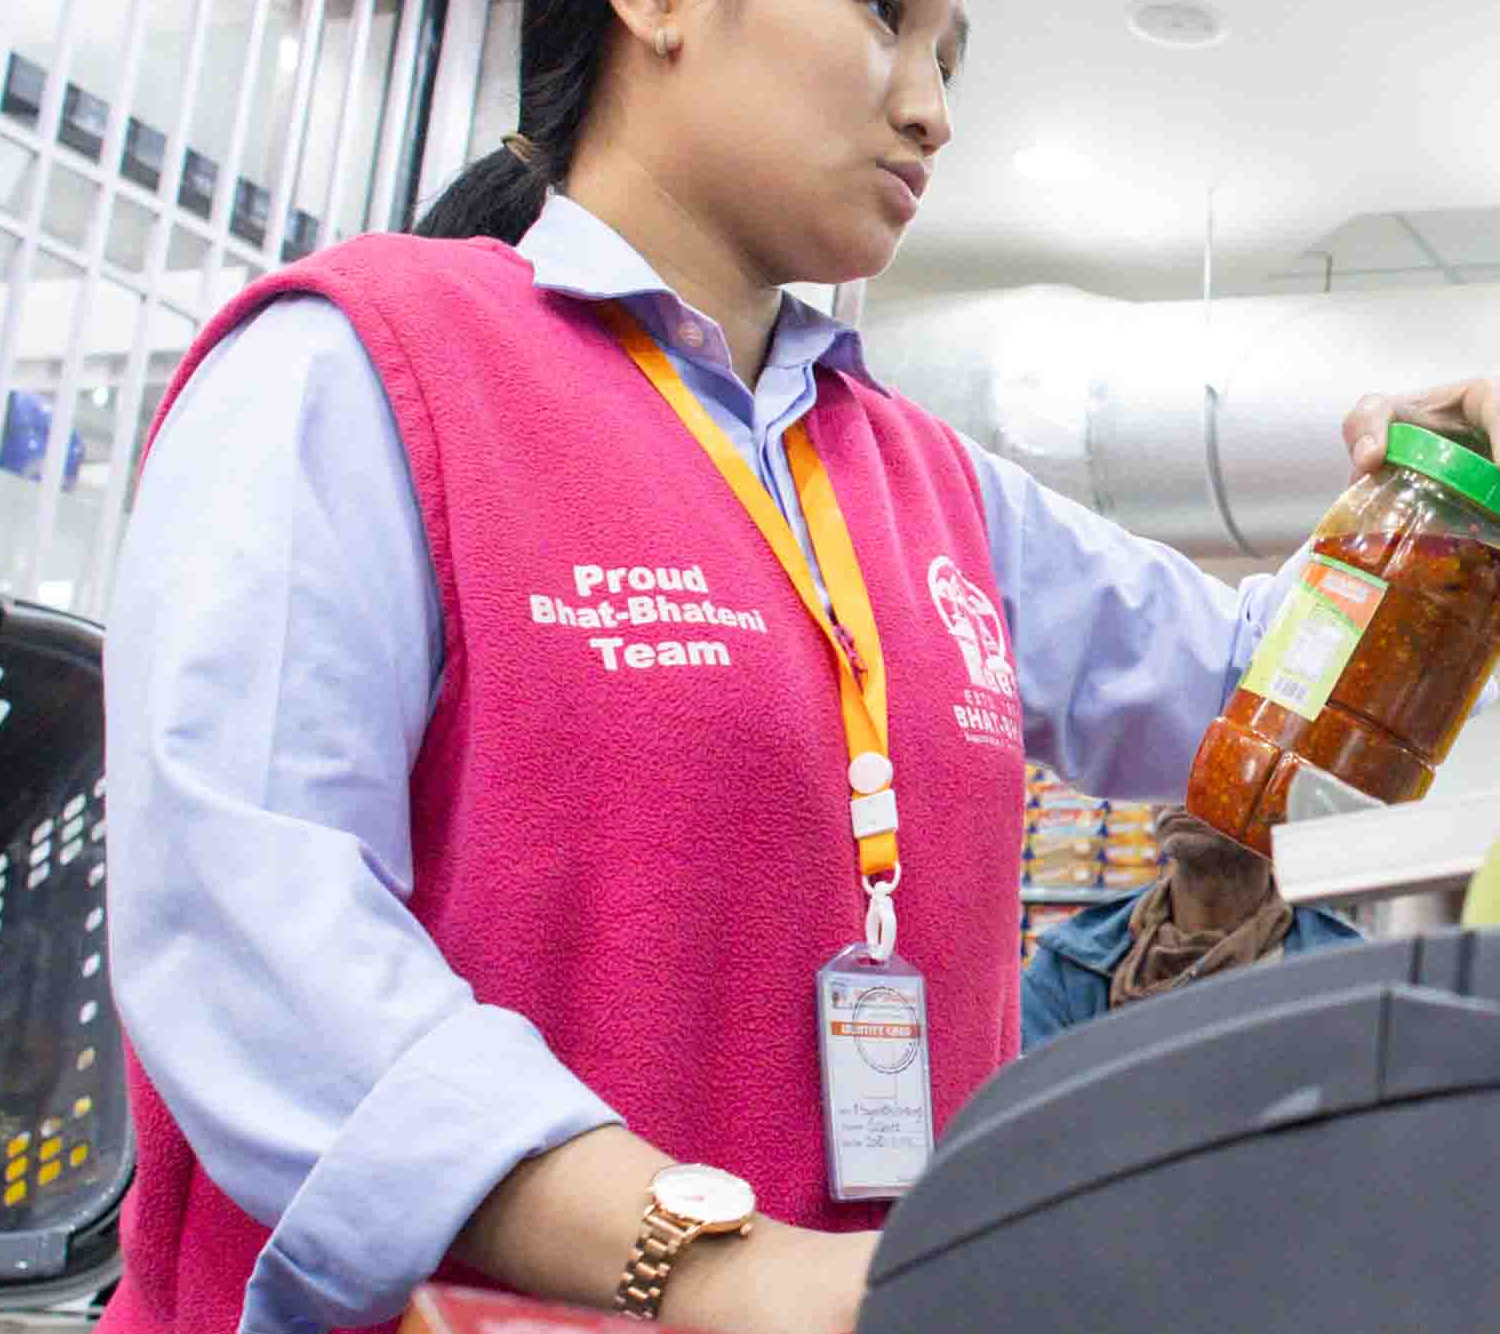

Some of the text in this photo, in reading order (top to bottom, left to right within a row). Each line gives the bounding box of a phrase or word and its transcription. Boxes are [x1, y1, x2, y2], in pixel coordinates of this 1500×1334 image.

[573, 564, 708, 597] Proud
[529, 594, 768, 634] Bhat-Bhateni
[589, 637, 730, 672] Team
